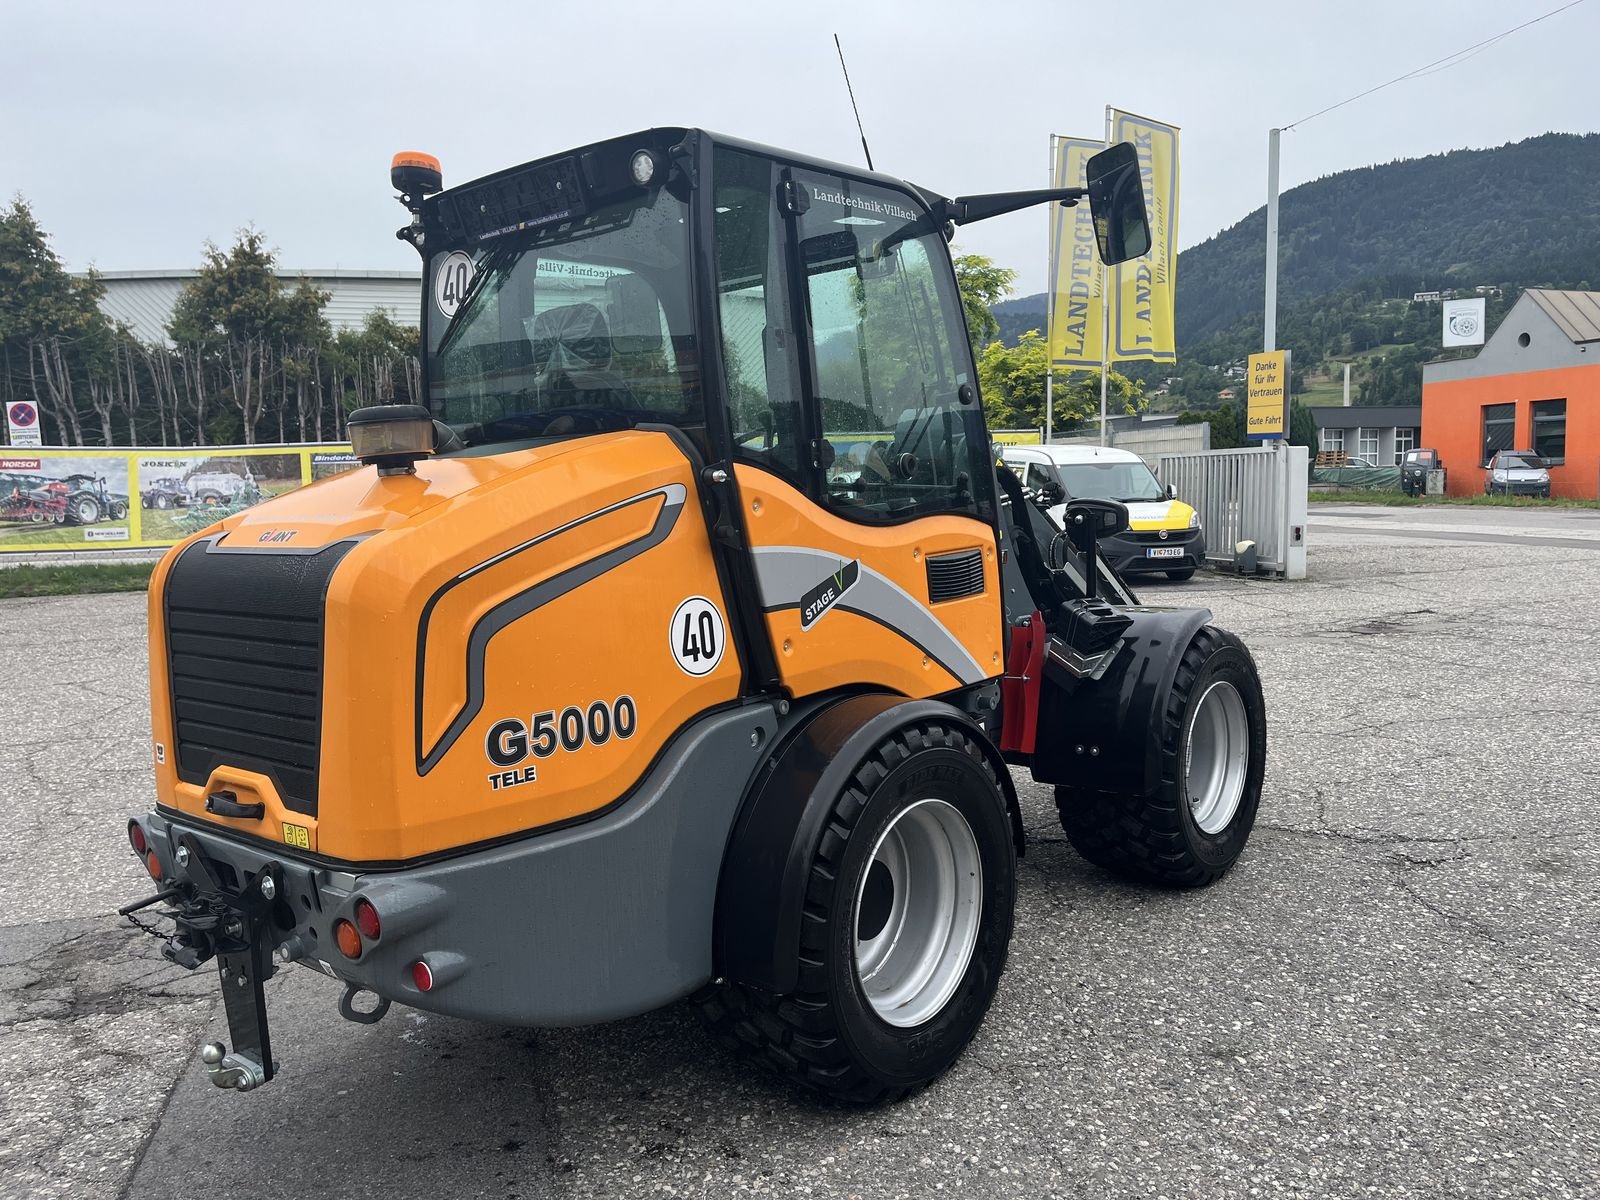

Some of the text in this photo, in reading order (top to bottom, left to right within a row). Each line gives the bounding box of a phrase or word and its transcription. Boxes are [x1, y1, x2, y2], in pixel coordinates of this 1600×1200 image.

[813, 188, 918, 221] Landtechnik-Villach
[1156, 240, 1166, 285] Villach
[443, 262, 467, 306] 40
[1093, 257, 1102, 299] Villach
[1255, 361, 1277, 371] Danke
[1255, 374, 1276, 384] für Ihr
[1249, 387, 1282, 398] Vertrauen
[1248, 416, 1281, 426] Gute Fahrt
[141, 460, 187, 468] JOSKIN
[258, 528, 297, 542] GIANT
[805, 587, 835, 620] STAGE
[683, 610, 715, 662] 40
[485, 695, 637, 767] G5000
[488, 766, 536, 790] TELE
